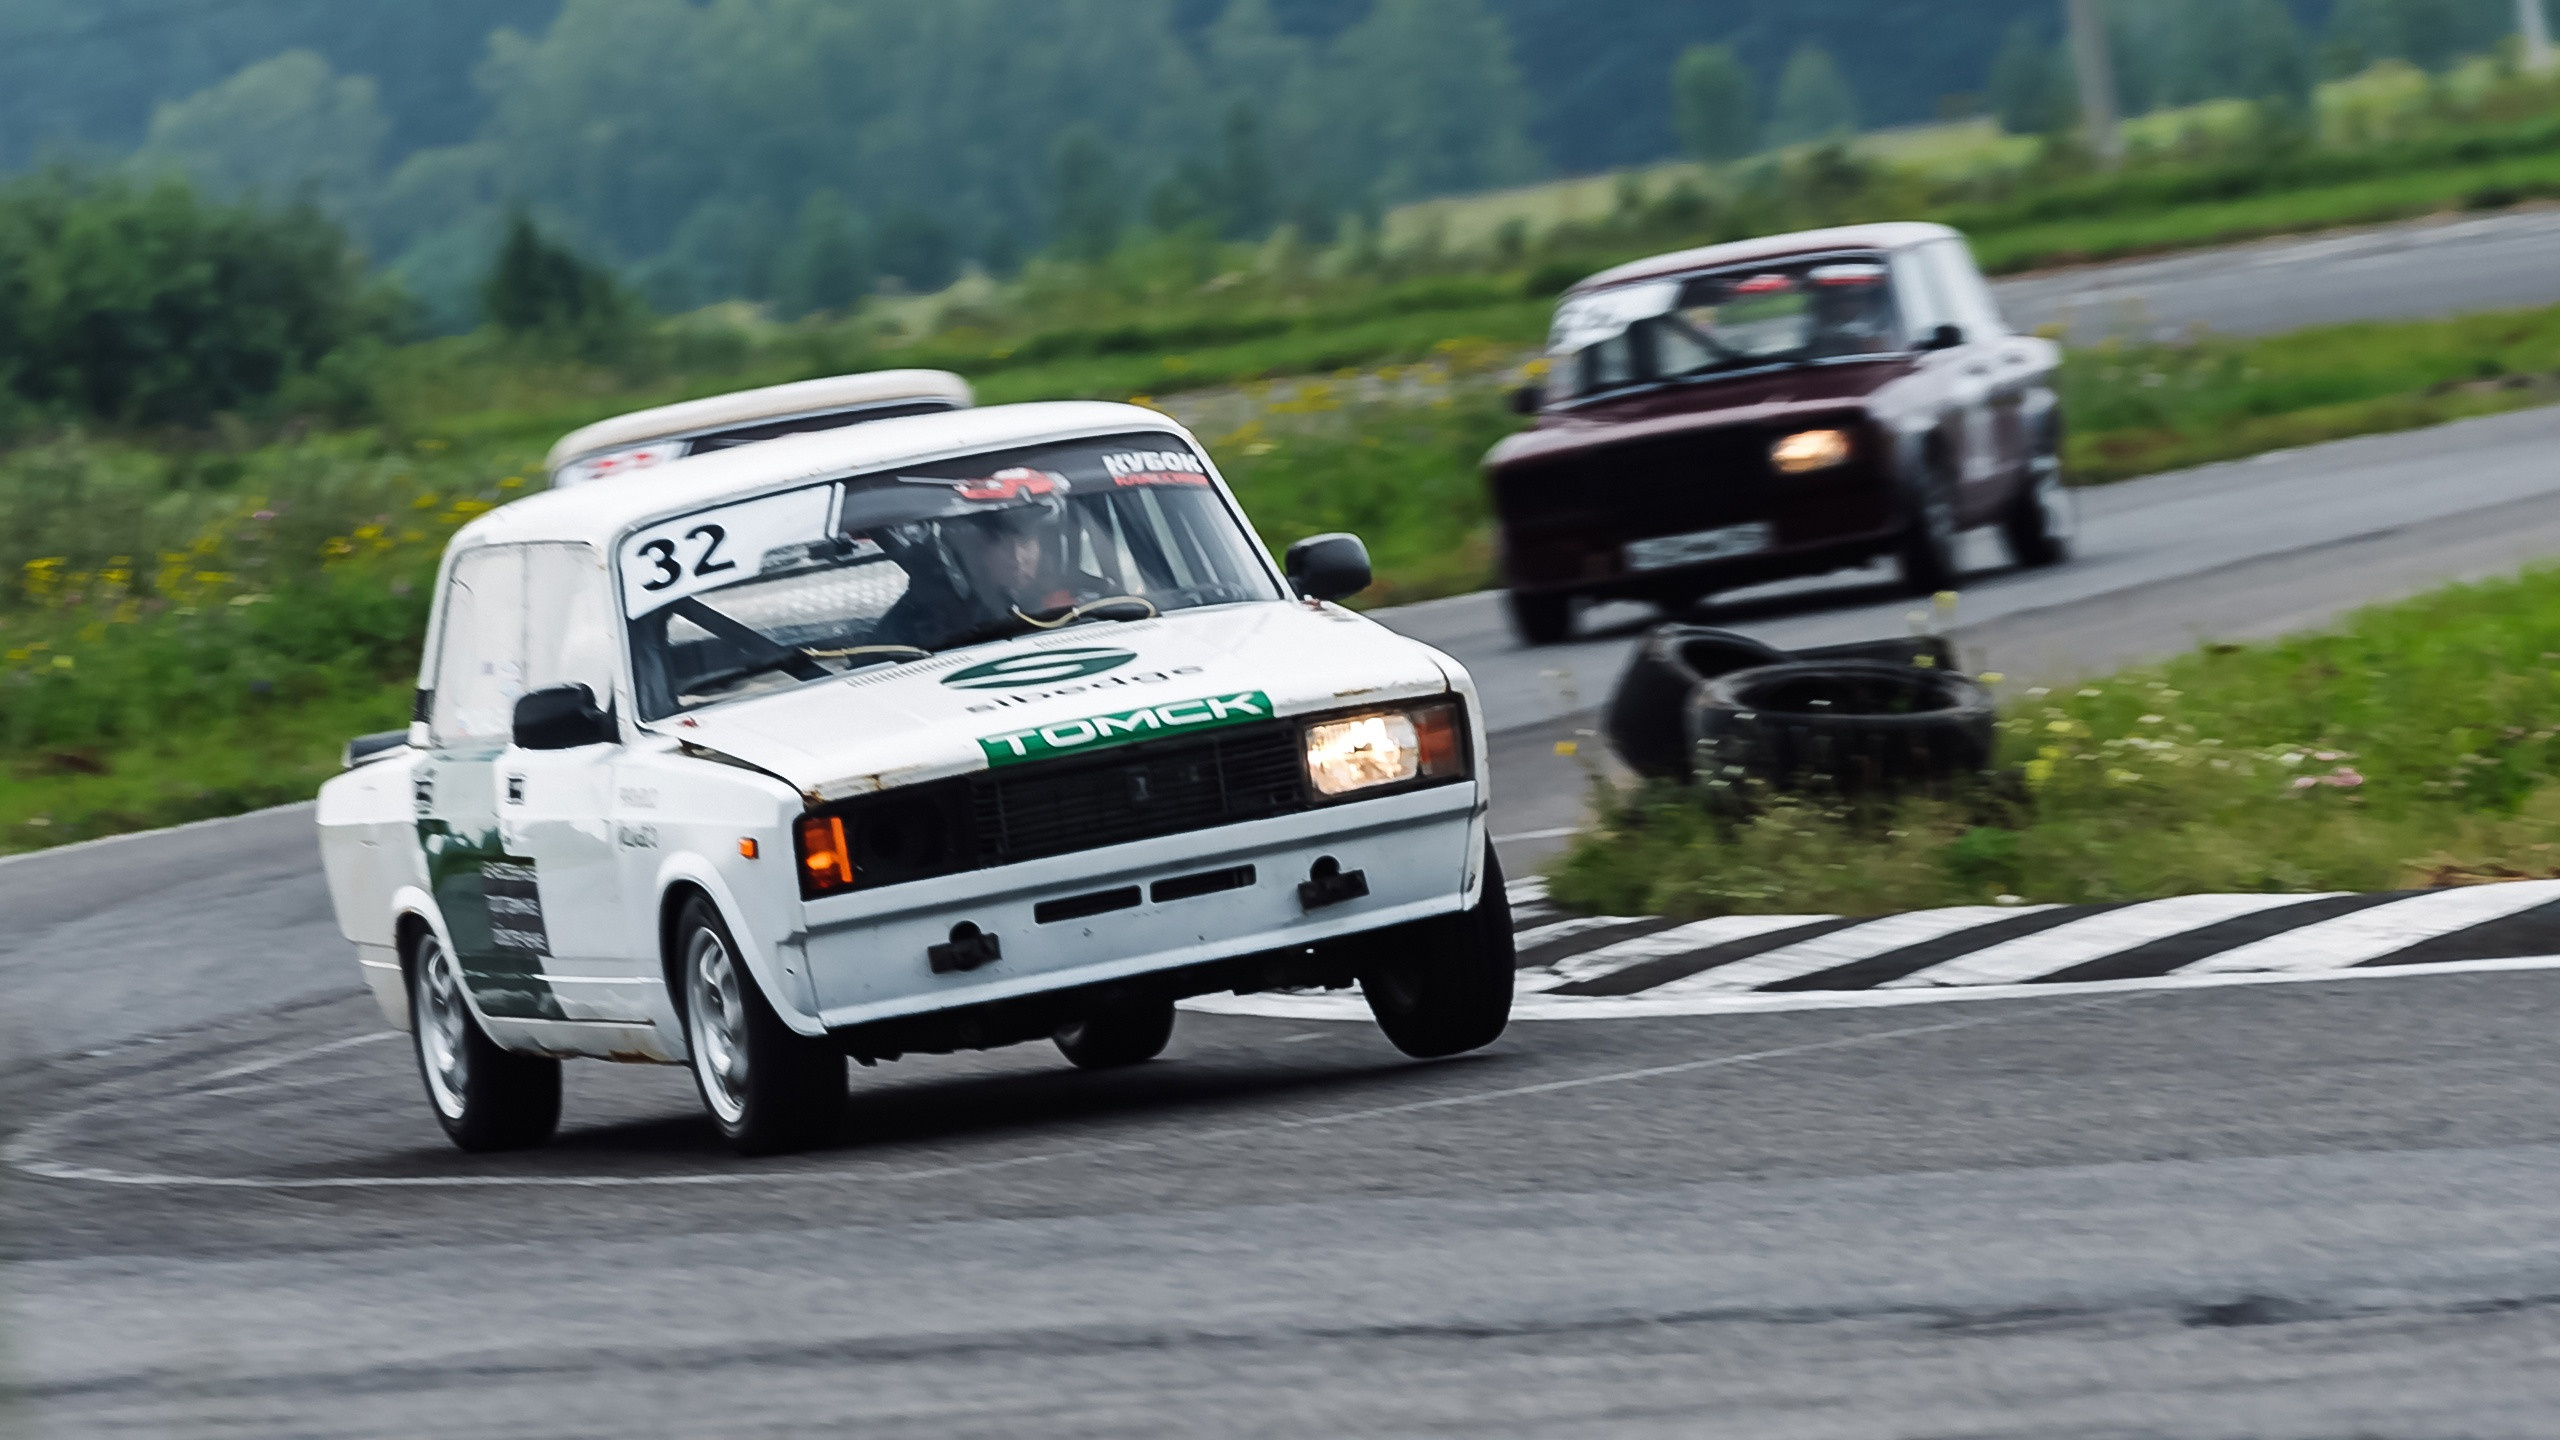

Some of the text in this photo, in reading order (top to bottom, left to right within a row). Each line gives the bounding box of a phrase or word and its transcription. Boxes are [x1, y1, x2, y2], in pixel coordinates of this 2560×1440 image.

[1101, 451, 1204, 476] КУБОК
[637, 524, 736, 591] 32
[984, 692, 1264, 756] ТОМСК
